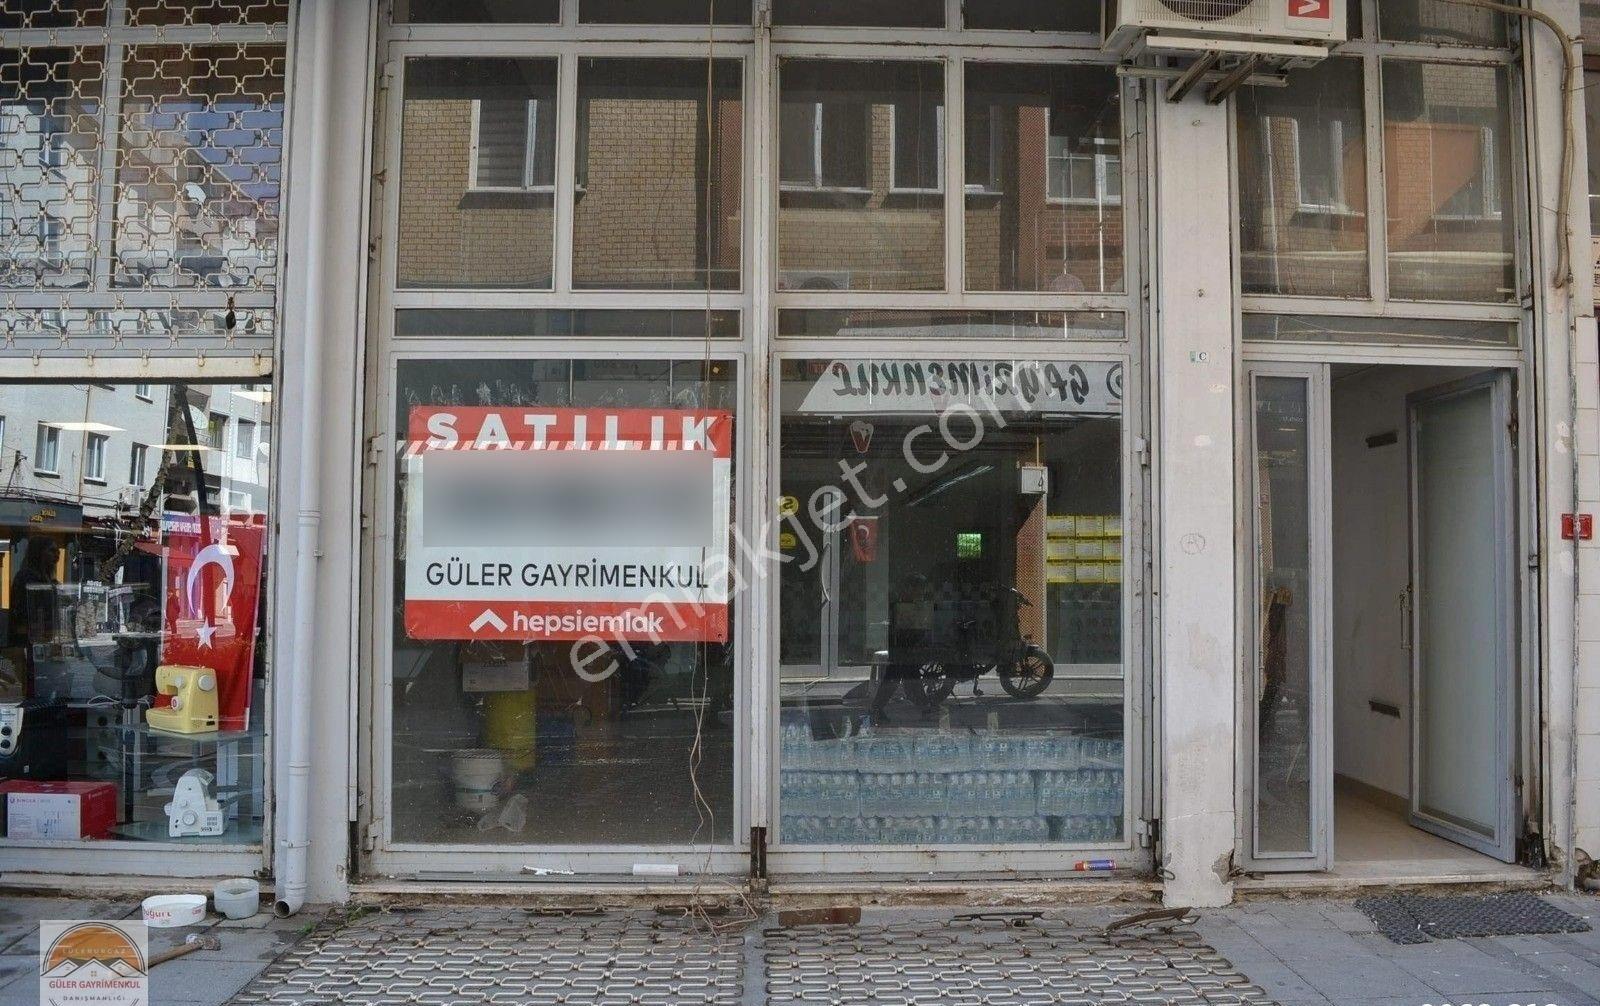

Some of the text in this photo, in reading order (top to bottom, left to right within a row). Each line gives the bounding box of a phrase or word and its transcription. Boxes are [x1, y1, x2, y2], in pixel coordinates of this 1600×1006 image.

[424, 412, 718, 451] SATILIK
[426, 557, 709, 588] GÜLER GAYRİMENKUL
[512, 609, 664, 636] hepsiemlak
